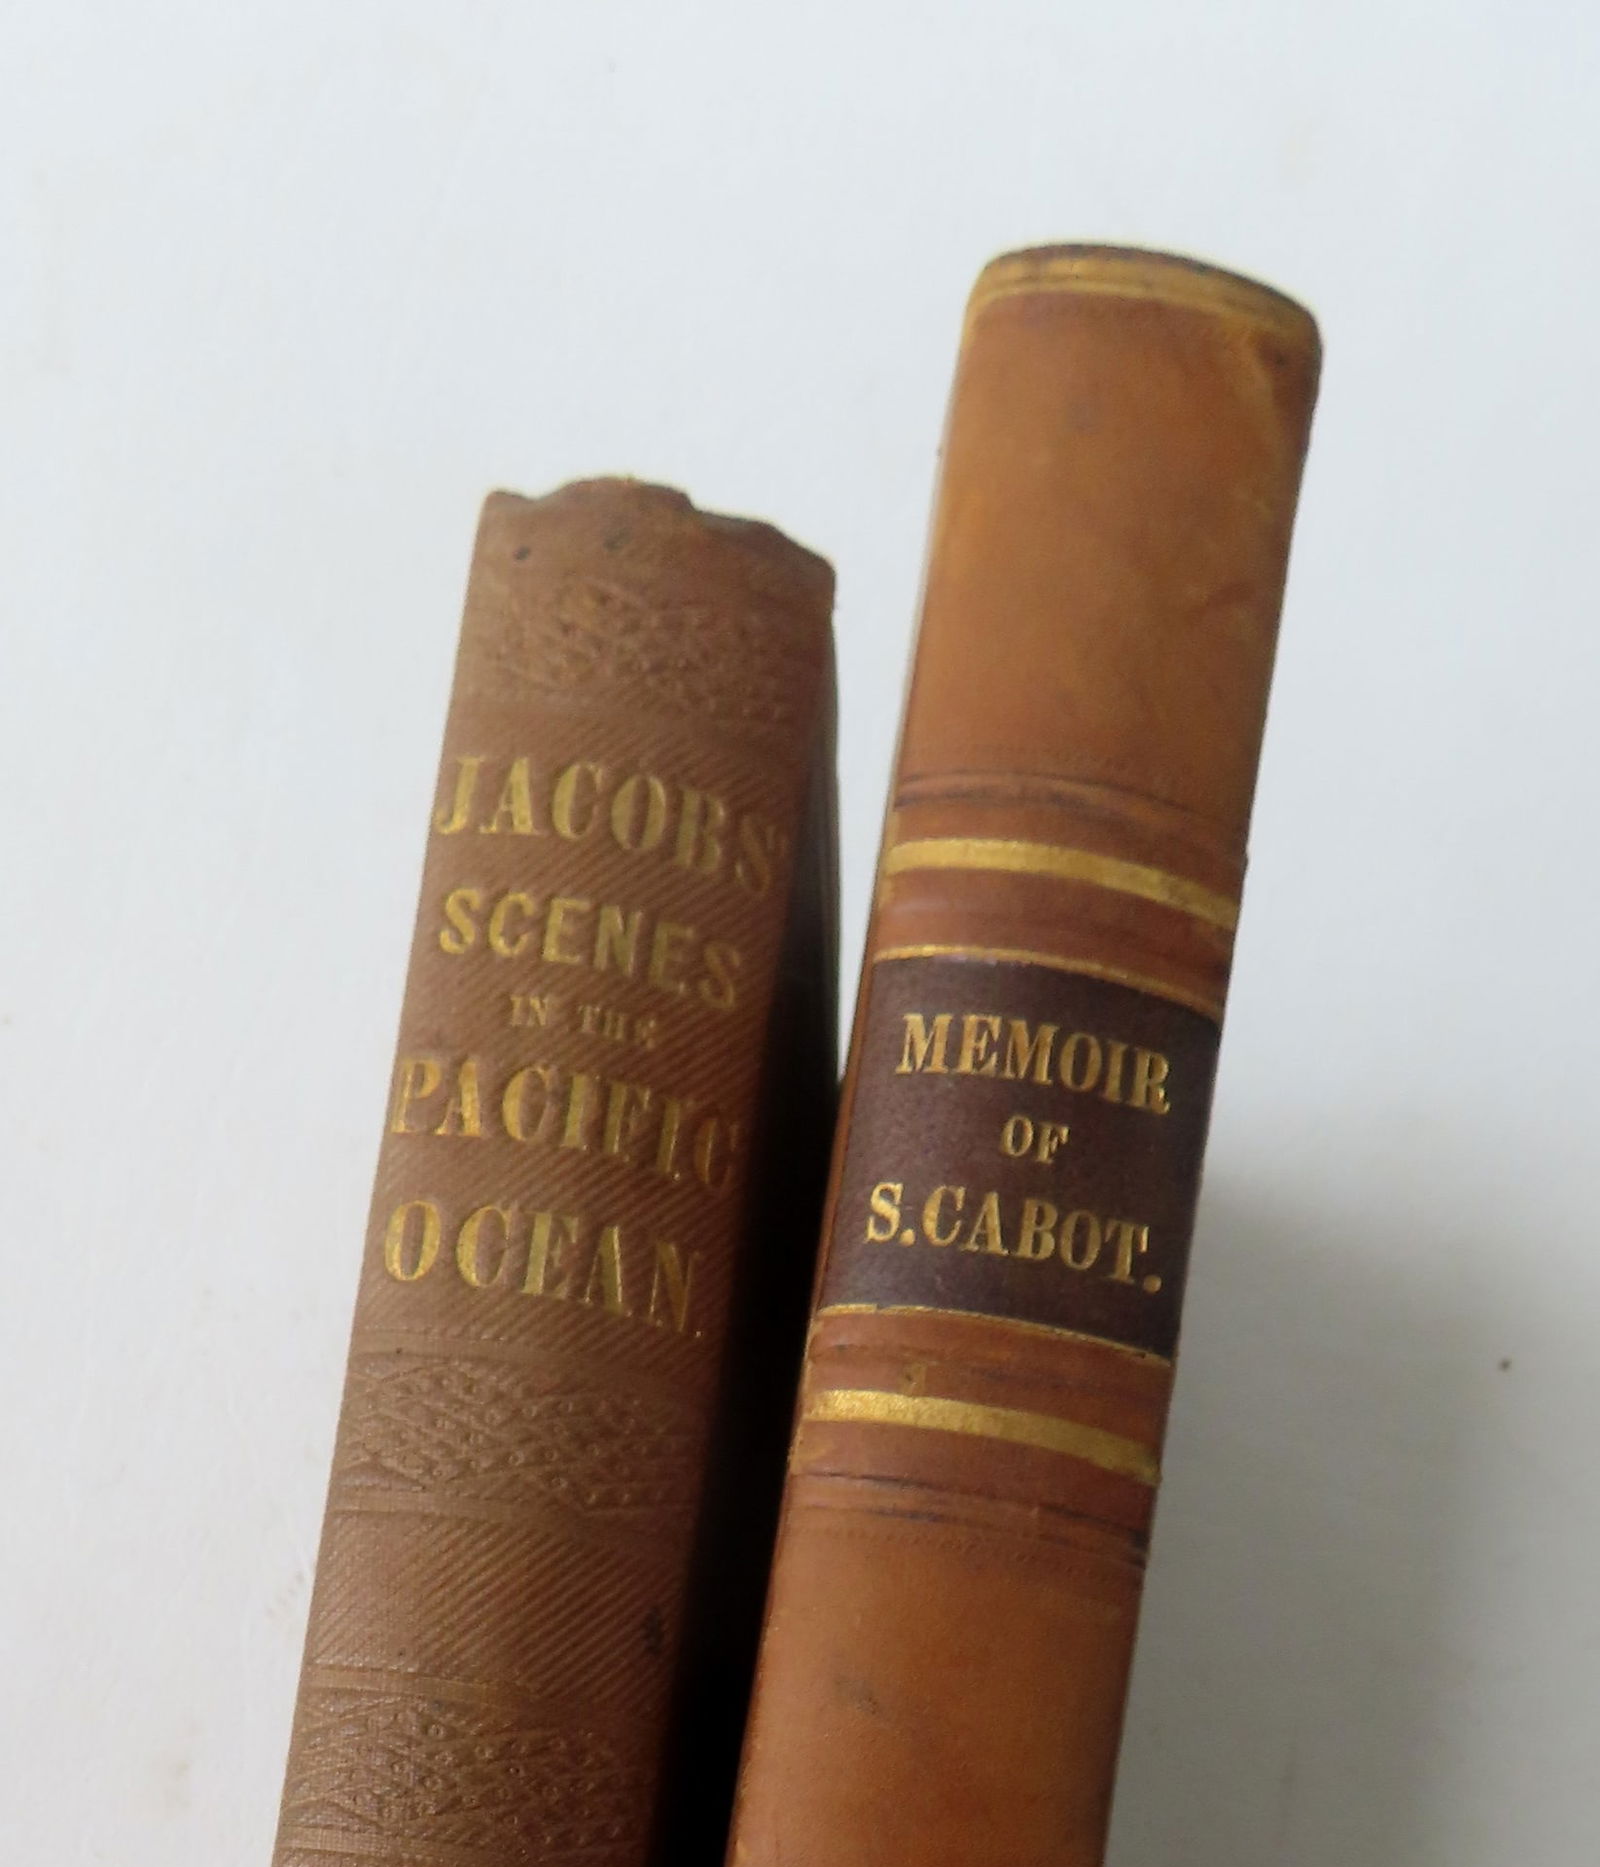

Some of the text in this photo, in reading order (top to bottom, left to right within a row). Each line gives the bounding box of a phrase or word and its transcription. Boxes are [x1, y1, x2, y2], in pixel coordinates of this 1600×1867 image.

[438, 888, 741, 1011] SCENES
[510, 995, 657, 1049] IN THE
[895, 1012, 1171, 1115] MEMOIR
[390, 1058, 741, 1190] PACIFIC
[1001, 1114, 1070, 1164] OF
